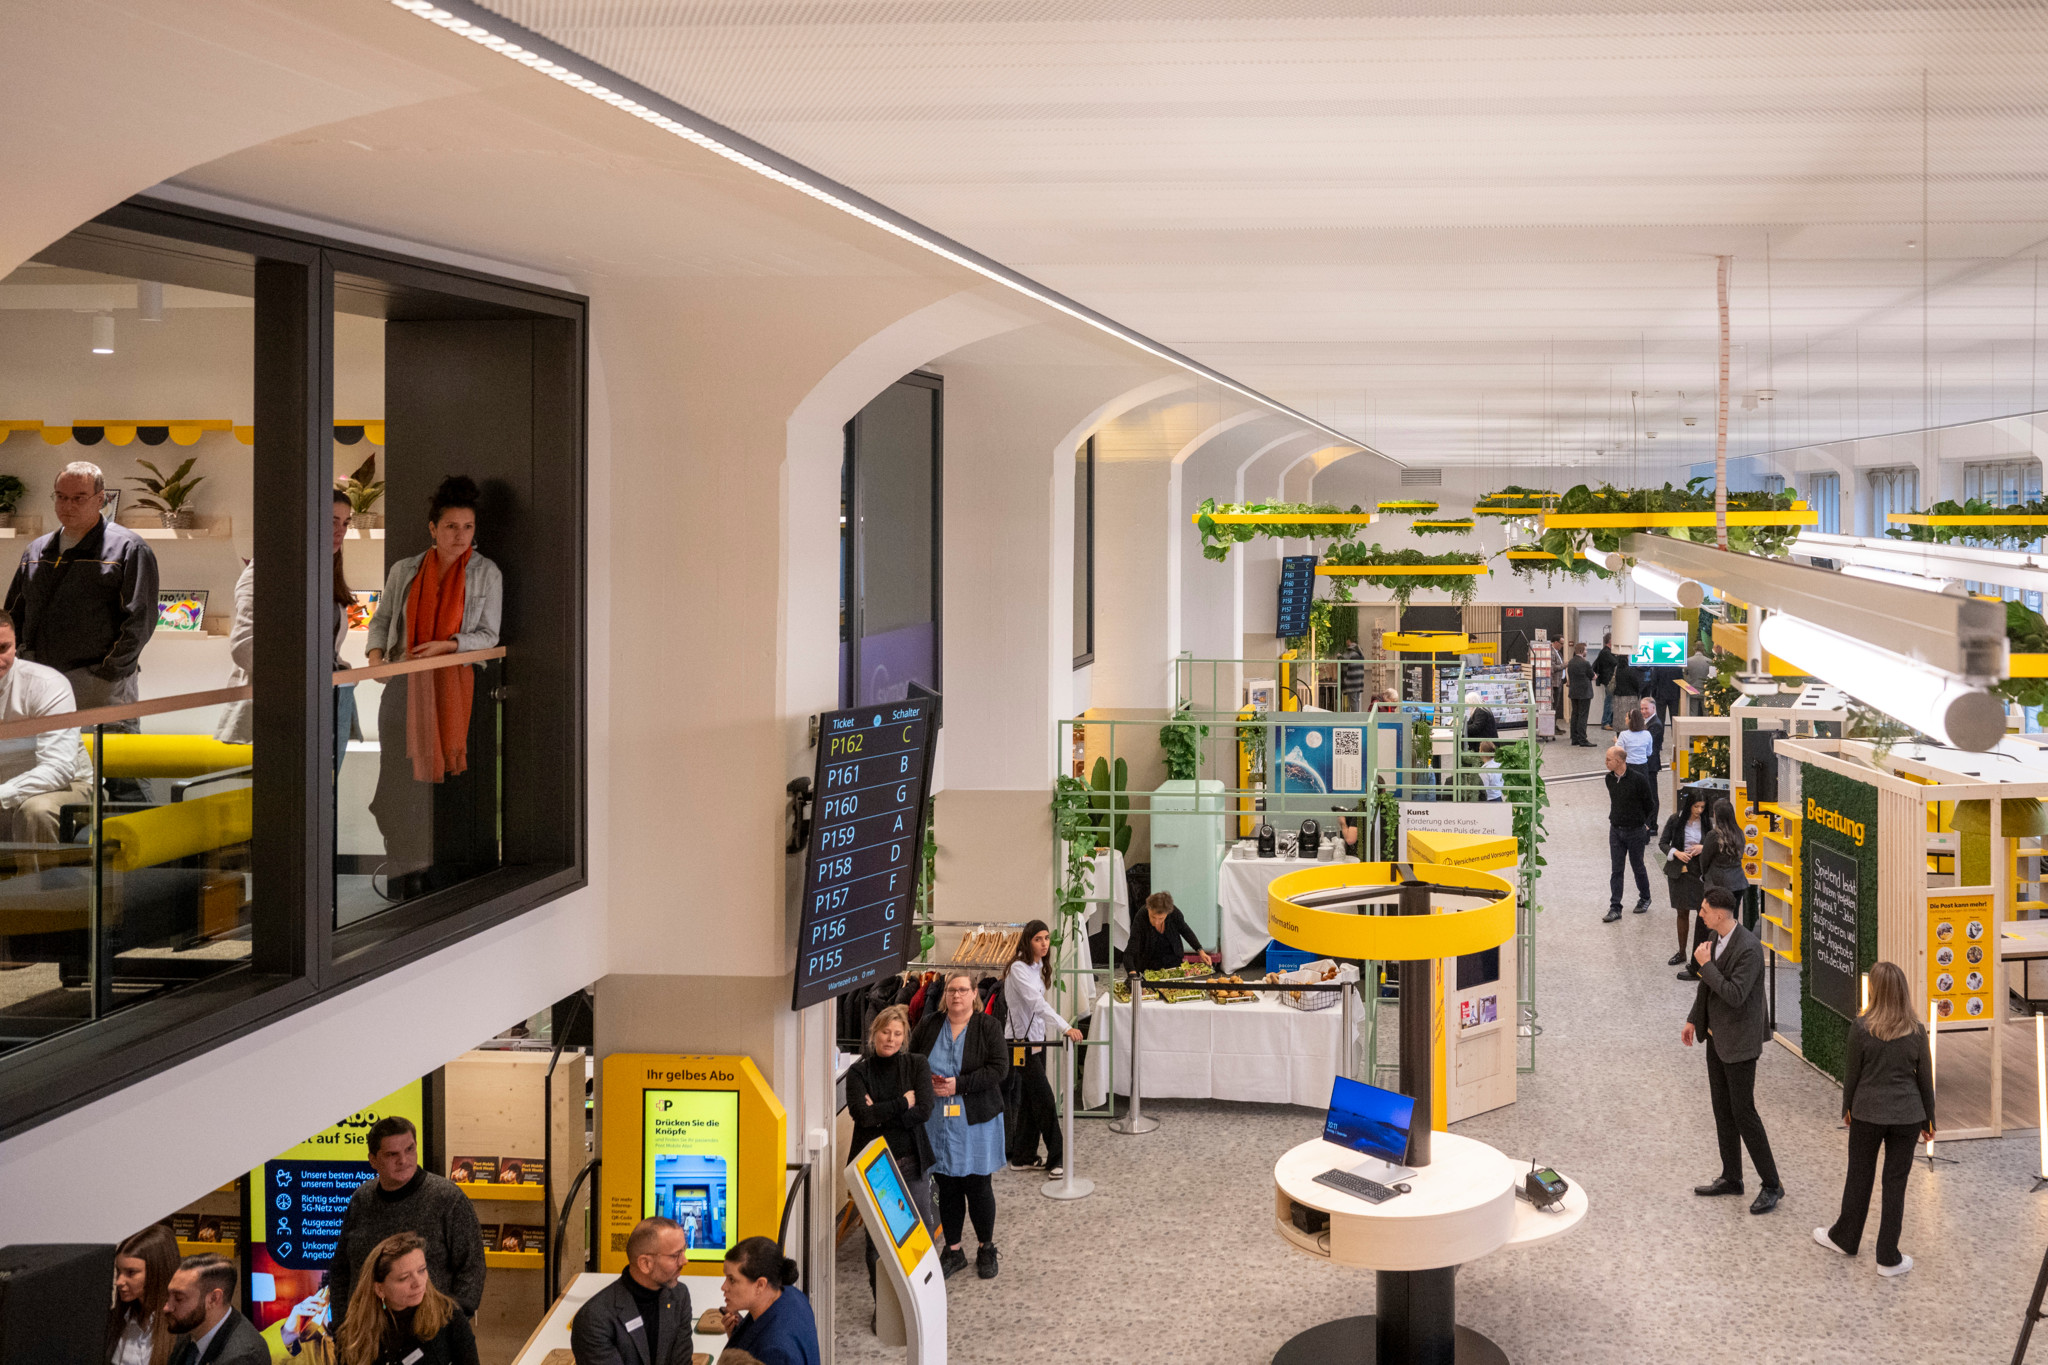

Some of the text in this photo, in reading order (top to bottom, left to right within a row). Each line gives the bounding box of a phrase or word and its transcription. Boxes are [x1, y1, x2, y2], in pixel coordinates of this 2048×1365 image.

[833, 707, 920, 729] Ticket Schalter
[830, 725, 912, 757] P162 C
[827, 755, 909, 788] P161 B
[824, 784, 907, 820] P160 G
[821, 814, 904, 851] P159 A
[1807, 797, 1865, 847] Beratung
[818, 844, 901, 883] P158 D
[1453, 849, 1515, 866] Versichern und Vorsorgen
[1814, 858, 1841, 888] Spielend
[815, 873, 897, 914] P157 F
[812, 902, 895, 945] P156 G
[1271, 911, 1299, 933] Information
[1813, 912, 1855, 944] ausprobieren und
[808, 932, 891, 977] P155 E
[1813, 927, 1854, 960] tolle Angebote
[1817, 949, 1855, 978] entdecken!
[828, 977, 851, 991] Wartezeit
[861, 970, 866, 979] 0
[866, 969, 876, 977] min
[647, 1069, 735, 1082] Ihr gelbes Abo
[664, 1100, 673, 1111] P
[655, 1127, 687, 1136] Knöpfe
[692, 1119, 705, 1127] Sie
[706, 1119, 720, 1127] die
[316, 1132, 340, 1144] auf
[301, 1170, 327, 1179] Unsere
[328, 1170, 354, 1180] besten
[355, 1171, 375, 1180] Abos
[335, 1180, 361, 1189] besten
[301, 1194, 327, 1205] Richtig
[301, 1203, 333, 1212] 5G-Netz
